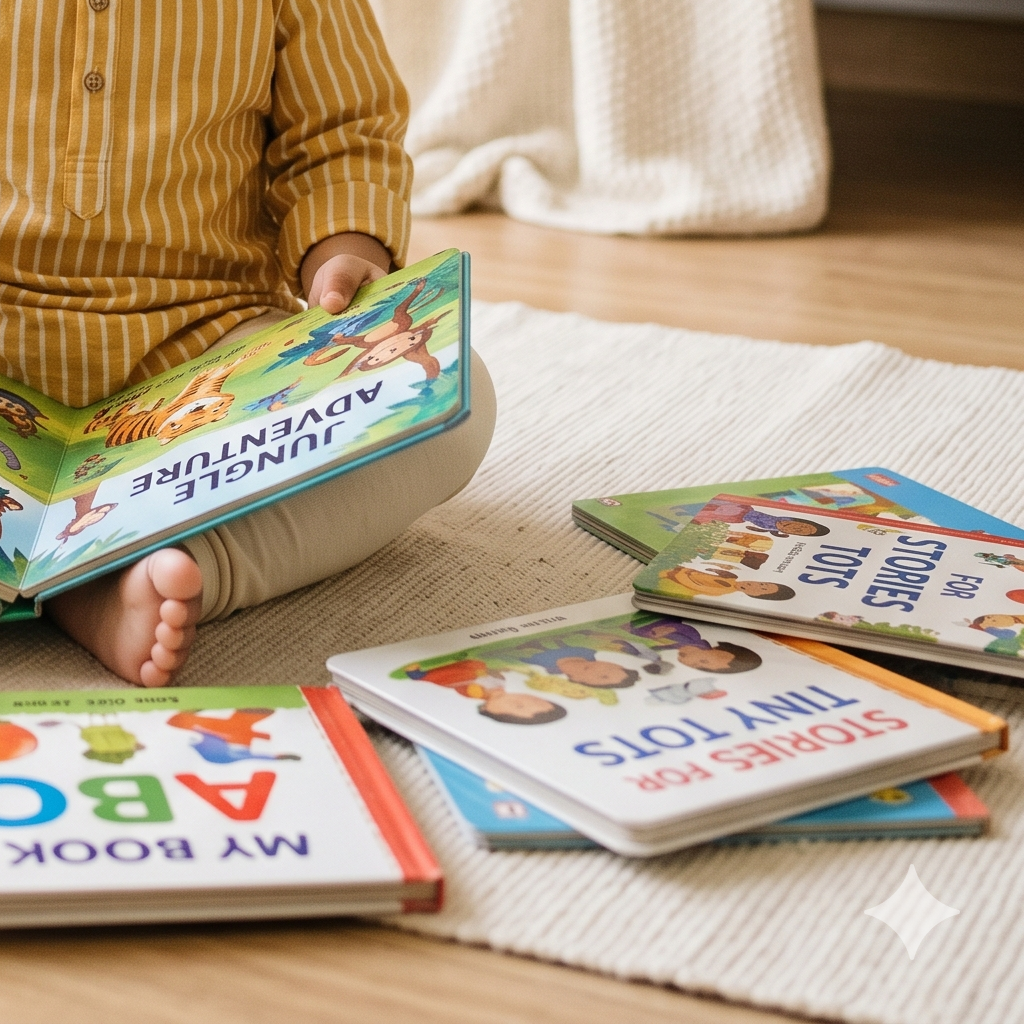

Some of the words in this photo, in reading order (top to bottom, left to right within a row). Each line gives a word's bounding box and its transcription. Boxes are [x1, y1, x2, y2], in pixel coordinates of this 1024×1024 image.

[130, 380, 383, 497] ADVENTURE
[173, 421, 345, 505] JUNGLE
[797, 544, 872, 589] TOTS
[861, 535, 947, 613] STORIES
[940, 573, 984, 599] FOR
[725, 685, 860, 730] TINY
[573, 718, 731, 766] TOTS
[709, 709, 909, 771] STORIES
[626, 761, 714, 793] FOR
[5, 838, 194, 865] BOOK
[221, 834, 308, 858] MY
